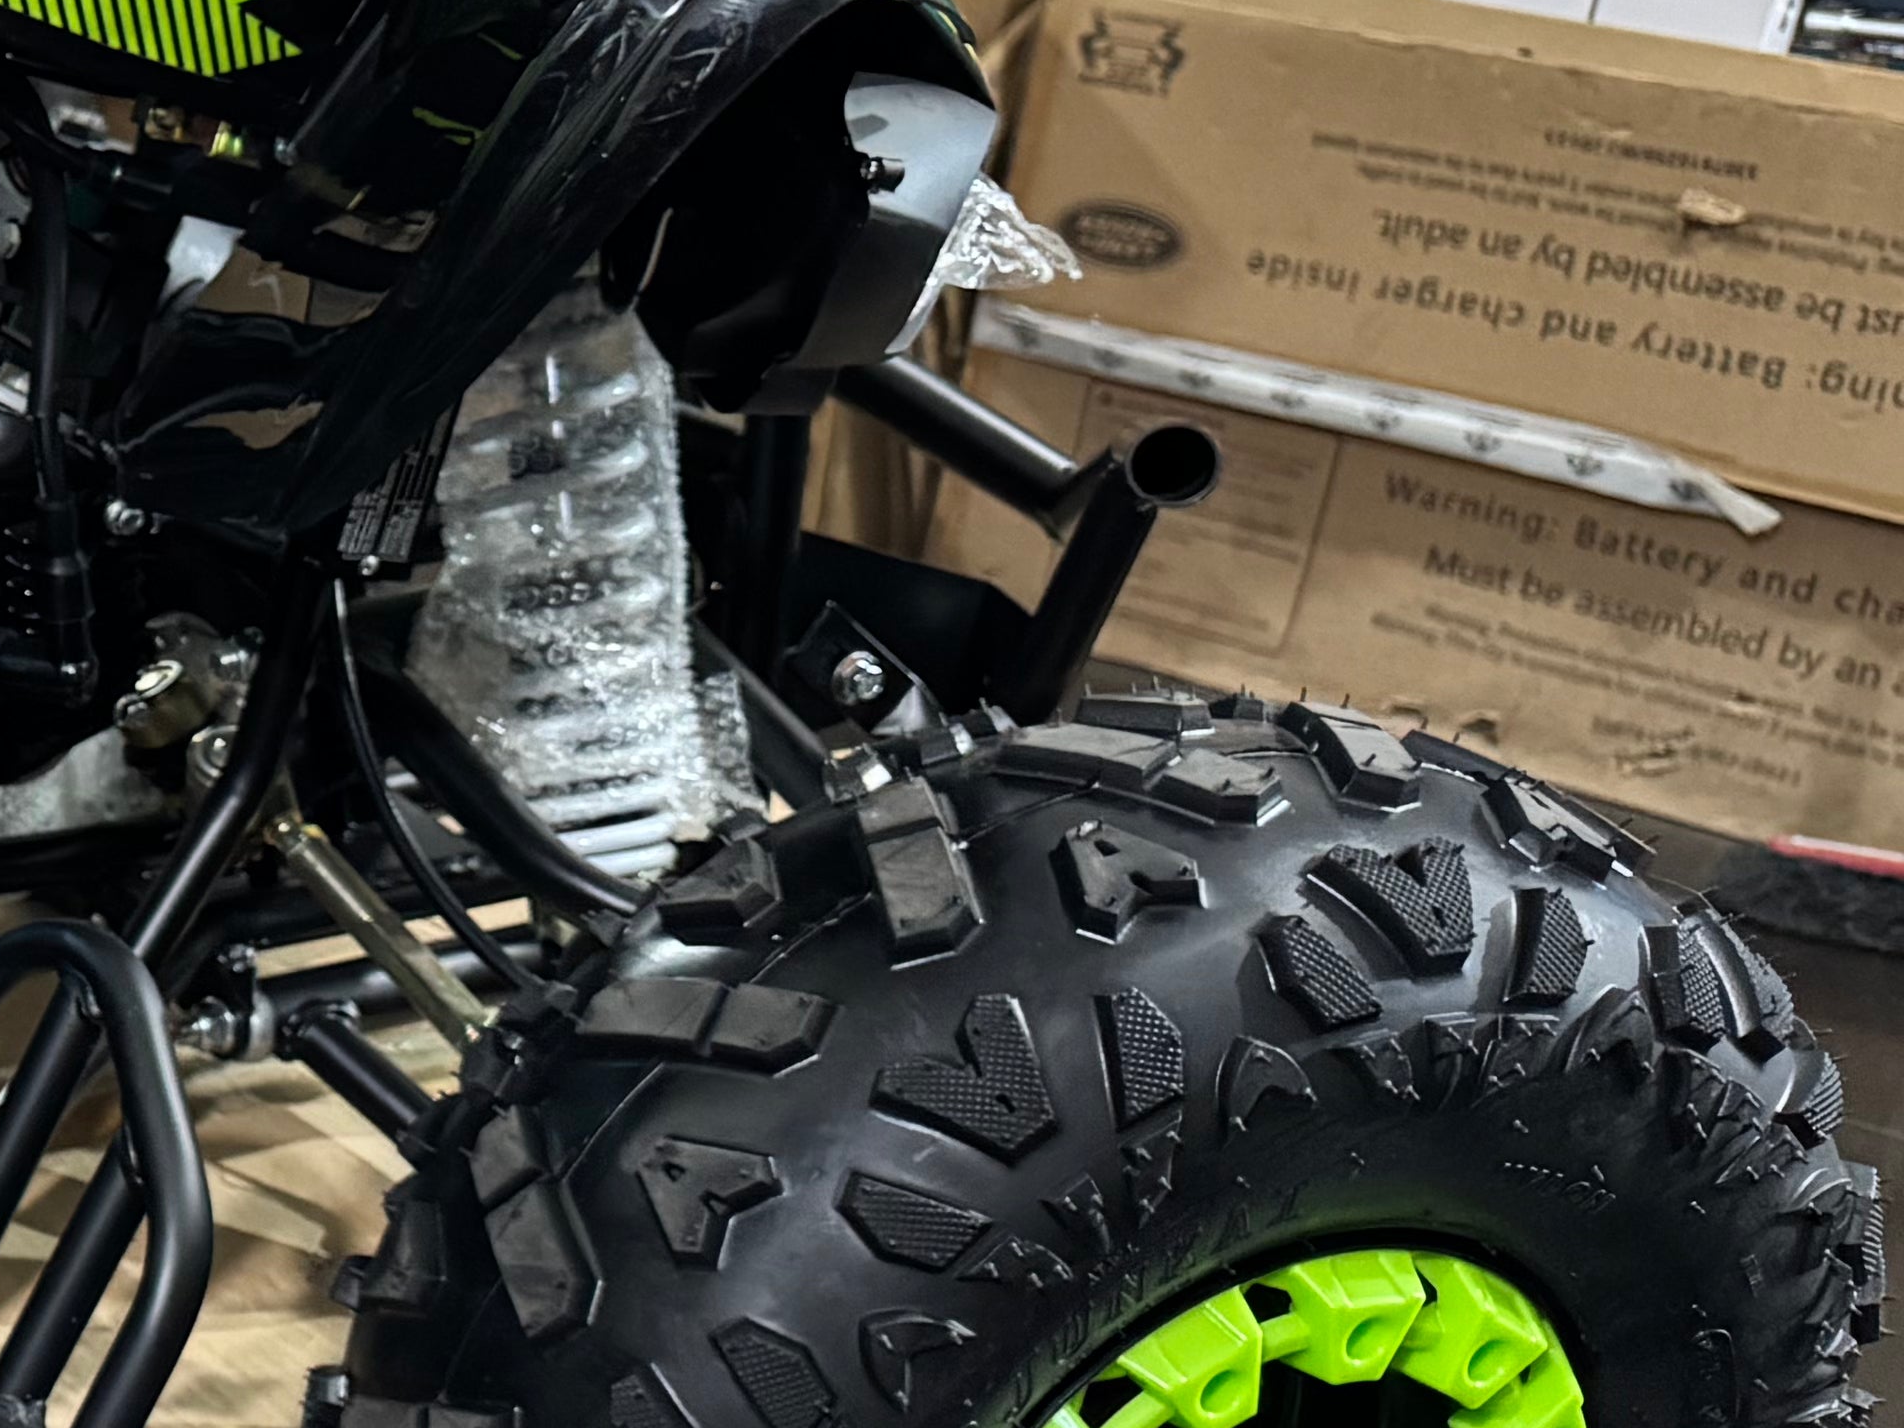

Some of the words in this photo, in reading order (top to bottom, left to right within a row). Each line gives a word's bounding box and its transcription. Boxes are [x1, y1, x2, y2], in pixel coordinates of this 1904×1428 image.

[1246, 248, 1362, 295] inside
[1478, 232, 1523, 262] an
[1534, 233, 1577, 269] by
[1374, 274, 1527, 329] charger
[1586, 245, 1785, 314] assembled
[1540, 307, 1616, 346] and
[1795, 291, 1844, 335] be
[1632, 323, 1786, 390] Battery
[1384, 470, 1559, 544] Warning:
[1573, 514, 1728, 588] Battery
[1738, 566, 1819, 605] and
[1423, 544, 1512, 595] Must
[1520, 565, 1564, 605] be
[1572, 584, 1770, 662] assembled
[1777, 637, 1833, 677] by
[1833, 654, 1882, 691] an
